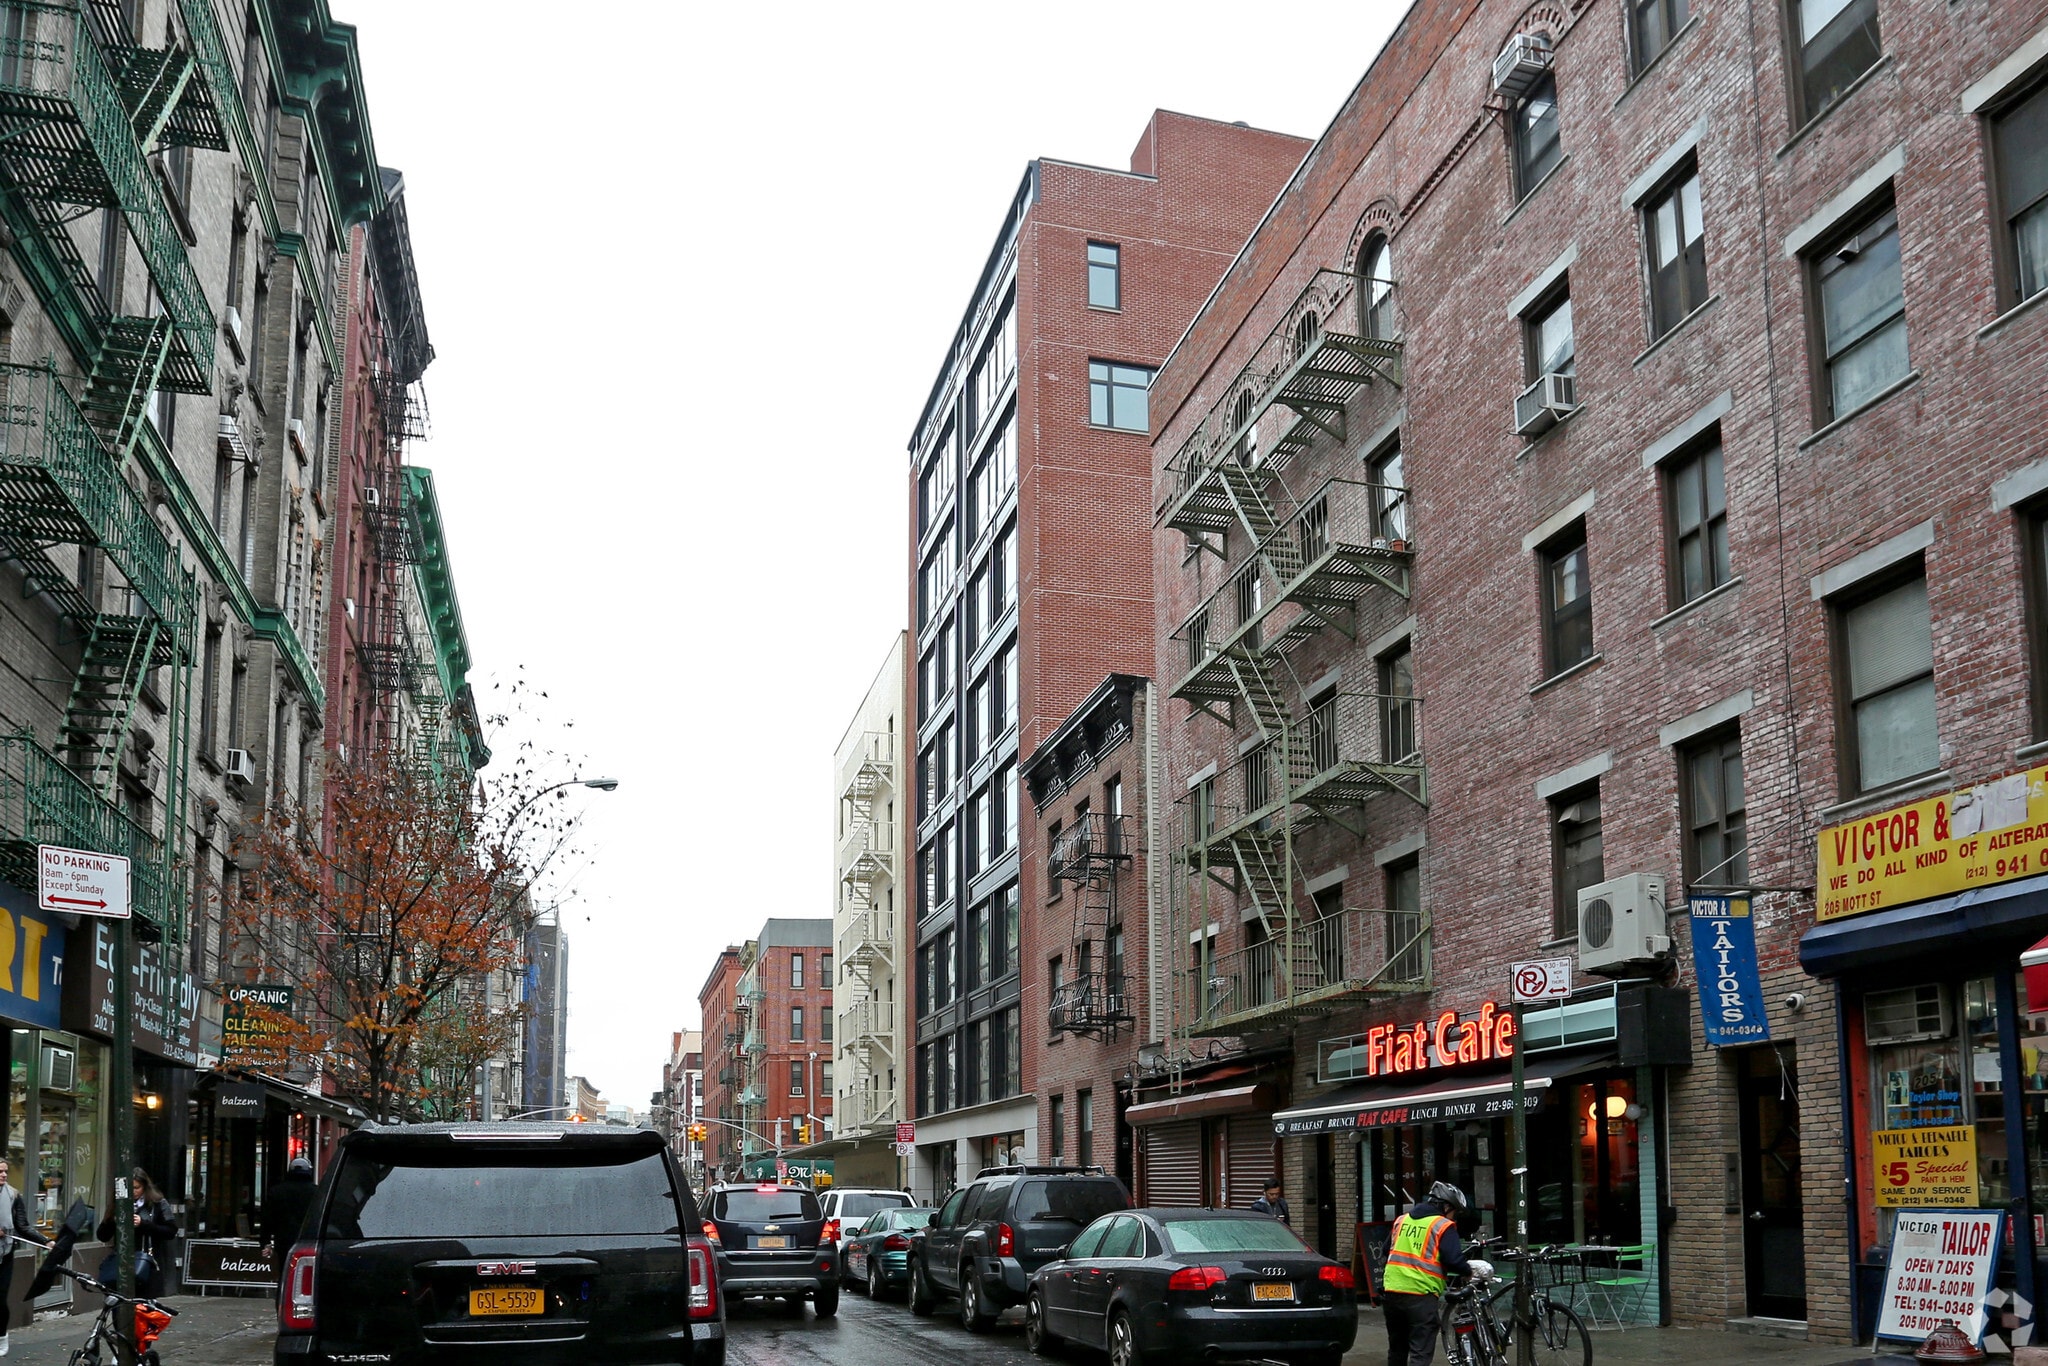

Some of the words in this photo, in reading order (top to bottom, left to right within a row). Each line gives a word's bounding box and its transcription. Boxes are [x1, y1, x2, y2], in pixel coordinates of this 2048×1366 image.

[1835, 810, 1919, 866] VICTOR
[1934, 801, 1949, 841] &
[45, 853, 61, 865] NO
[64, 856, 110, 872] PARKING
[1830, 874, 1848, 890] WE
[1858, 868, 1875, 884] DO
[1885, 860, 1906, 877] ALL
[1916, 849, 1948, 869] KIND
[1959, 841, 1978, 858] OF
[1966, 865, 1988, 879] (212)
[1996, 854, 2027, 877] 941
[45, 868, 63, 878] 8am
[71, 871, 89, 882] 6pm
[45, 879, 73, 892] Except
[75, 883, 104, 896] Sunday
[1691, 900, 1718, 916] VICTOR
[1721, 900, 1727, 915] &
[1825, 900, 1840, 915] 205
[1843, 894, 1867, 912] MOTT
[1870, 890, 1881, 906] ST
[1710, 921, 1744, 1022] TAILORS
[1368, 1021, 1427, 1076] Fiat
[1435, 1001, 1513, 1067] Cafe
[1915, 1073, 1937, 1088] 205
[221, 1096, 258, 1105] balzem
[1909, 1092, 1935, 1103] Taylor
[1938, 1090, 1959, 1102] Shop
[1289, 1120, 1324, 1132] BREAKFAST
[1328, 1117, 1355, 1128] BRUNCH
[1357, 1111, 1379, 1127] FIAT
[1380, 1108, 1408, 1125] CAFE
[1411, 1107, 1438, 1120] LUNCH
[1445, 1103, 1476, 1116] DINNER
[1878, 1133, 1906, 1145] VICTOR
[1899, 1145, 1949, 1158] TAILORS
[1915, 1161, 1969, 1177] Special
[1881, 1187, 1905, 1195] SAME
[1932, 1186, 1971, 1194] SERVICE
[1902, 1197, 1920, 1205] (212)
[1399, 1223, 1427, 1238] FIAT
[1899, 1221, 1938, 1234] VICTOR
[1942, 1221, 1991, 1256] TAILOR
[221, 1258, 272, 1272] balzem
[477, 1261, 536, 1275] GMC
[1905, 1258, 1935, 1273] OPEN
[1937, 1260, 1944, 1274] 7
[1945, 1260, 1975, 1276] DAYS
[1897, 1276, 1917, 1291] 8.30
[1917, 1278, 1932, 1293] AM
[1939, 1280, 1960, 1296] 8.00
[1960, 1281, 1975, 1297] PM
[1894, 1295, 1917, 1310] TEL:
[1919, 1297, 1974, 1316] 941-0348
[1899, 1314, 1917, 1329] 205
